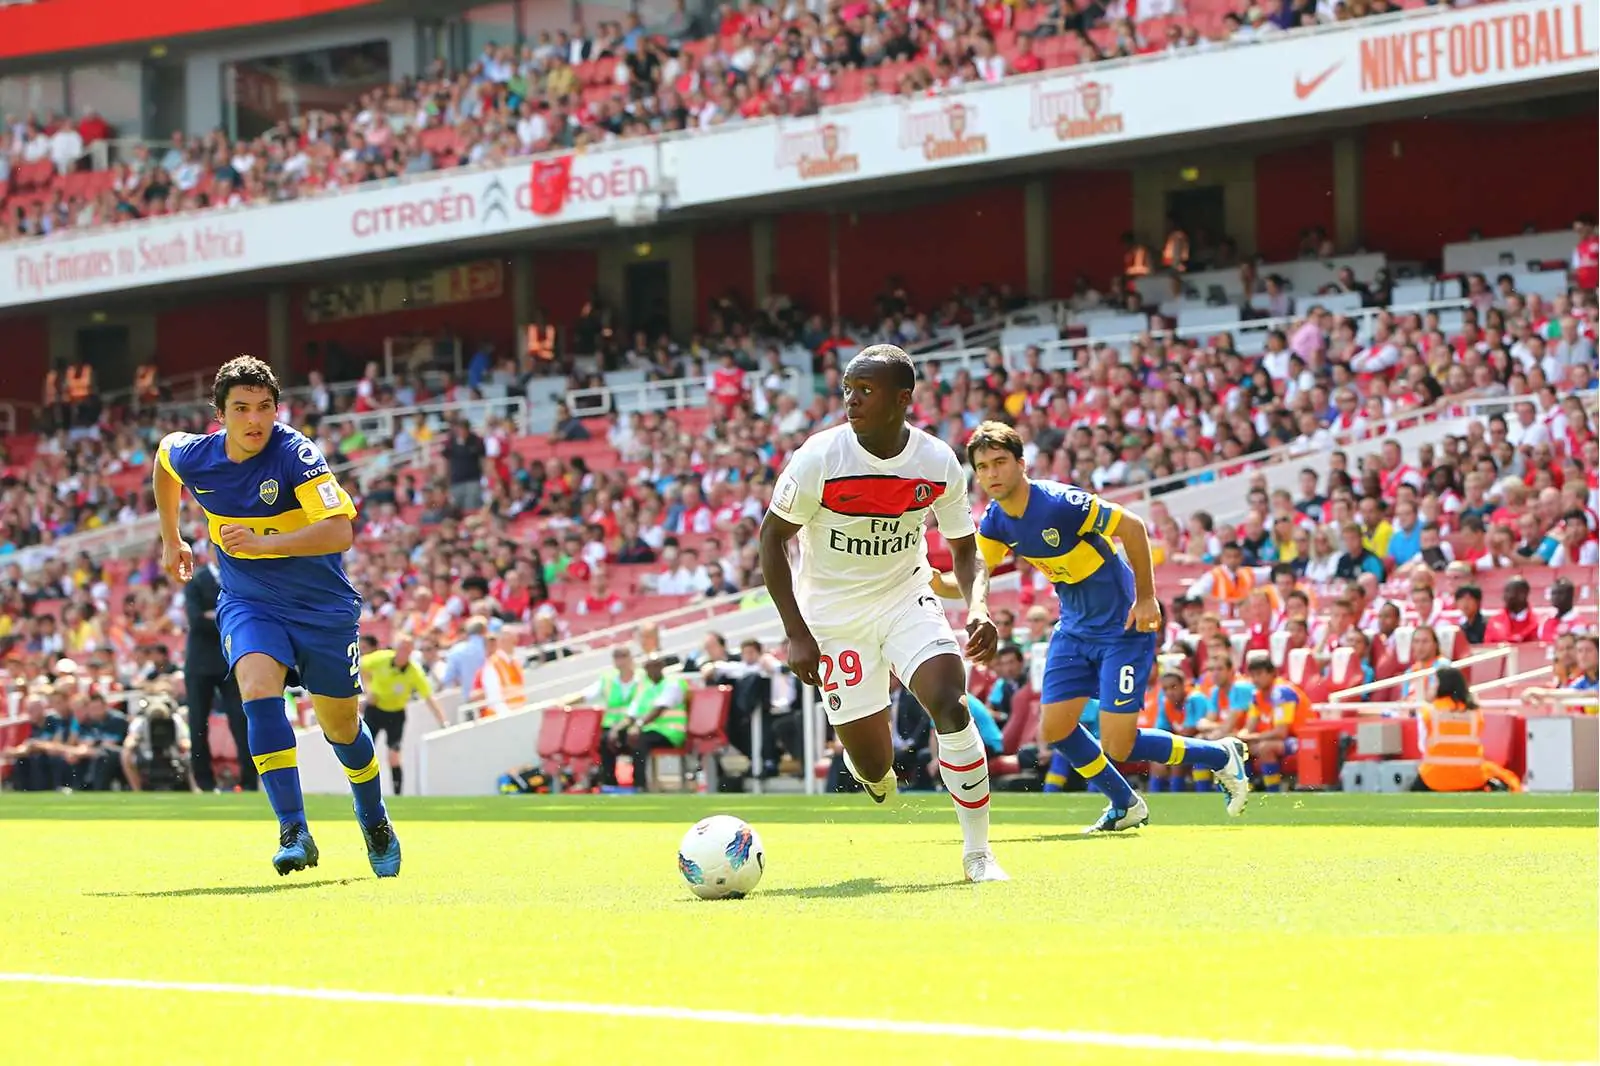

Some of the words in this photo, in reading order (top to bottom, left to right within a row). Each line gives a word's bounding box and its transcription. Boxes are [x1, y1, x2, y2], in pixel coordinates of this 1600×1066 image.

[1359, 4, 1594, 92] NIKEFOOTBALL
[515, 159, 648, 211] CROËN
[352, 187, 475, 238] CITROËN
[138, 232, 188, 271] South
[194, 224, 244, 262] Africa
[302, 464, 328, 479] TOTA
[830, 526, 920, 556] Emirat
[871, 519, 900, 534] Fly
[820, 650, 863, 692] 29
[1119, 665, 1134, 694] 6
